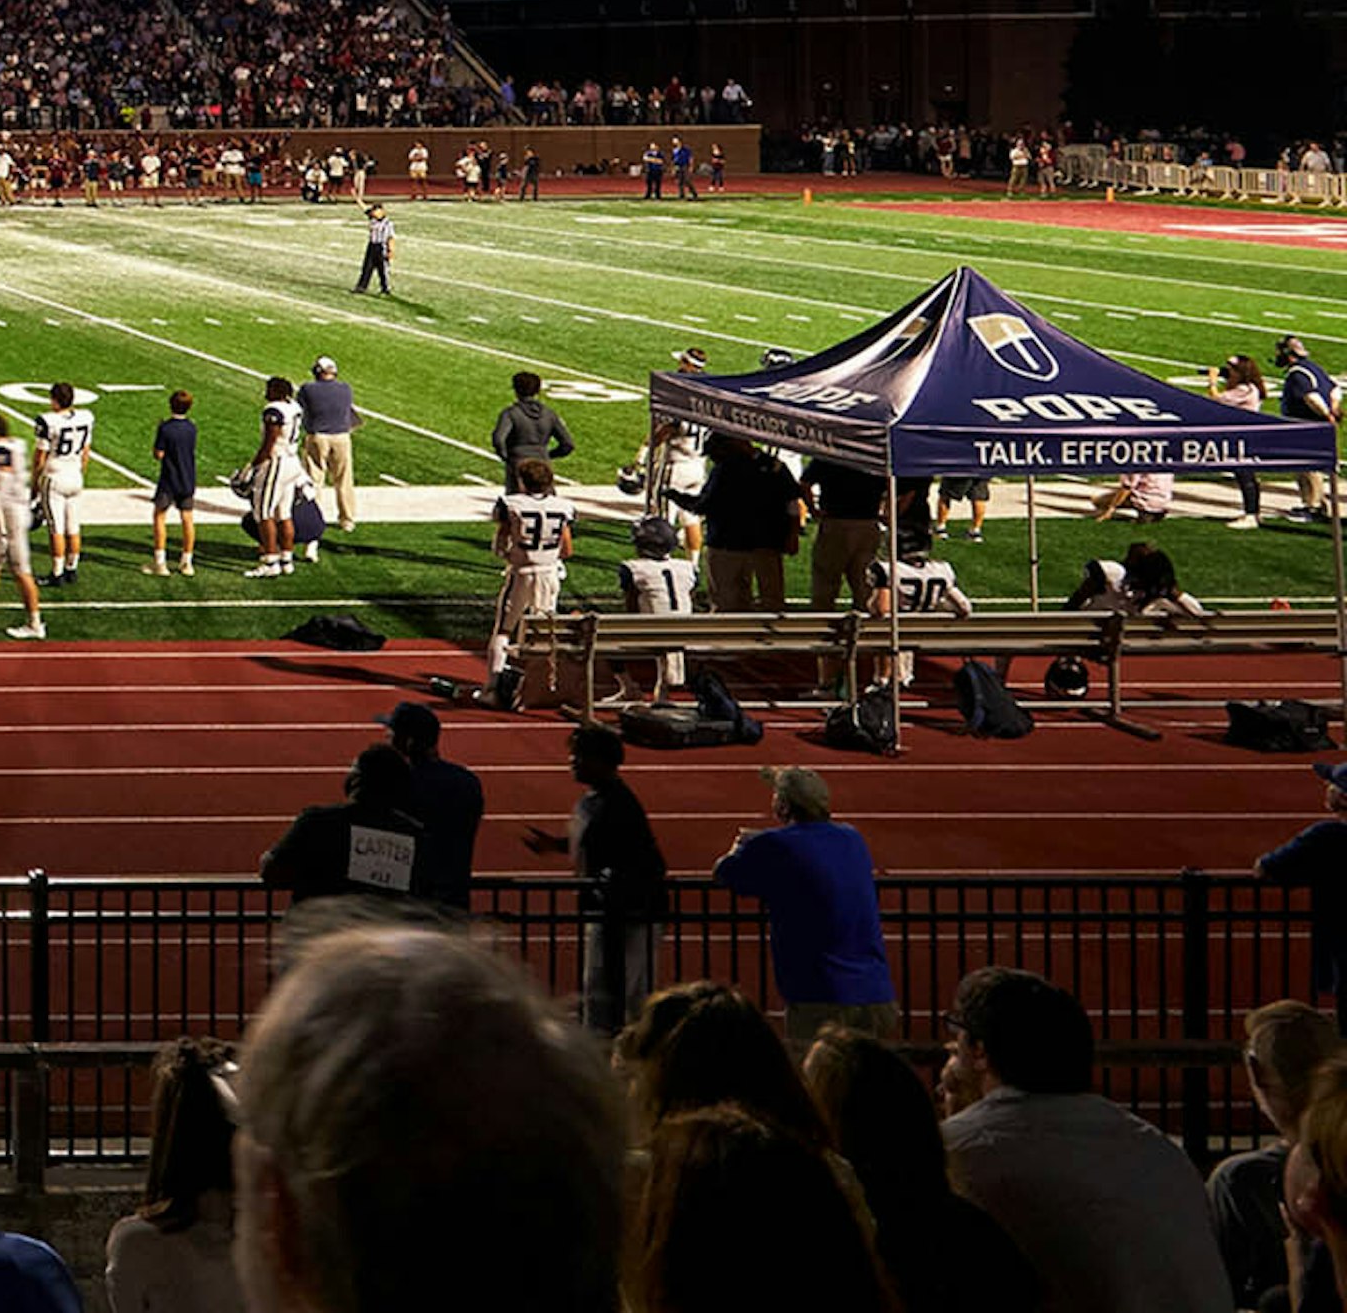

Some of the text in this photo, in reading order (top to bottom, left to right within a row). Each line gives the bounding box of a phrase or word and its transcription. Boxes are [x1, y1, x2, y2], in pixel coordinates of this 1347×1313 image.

[972, 392, 1181, 423] POPE
[57, 426, 89, 456] 67
[974, 439, 1261, 465] TALK. EFFORT. BALL.
[520, 511, 566, 551] 33
